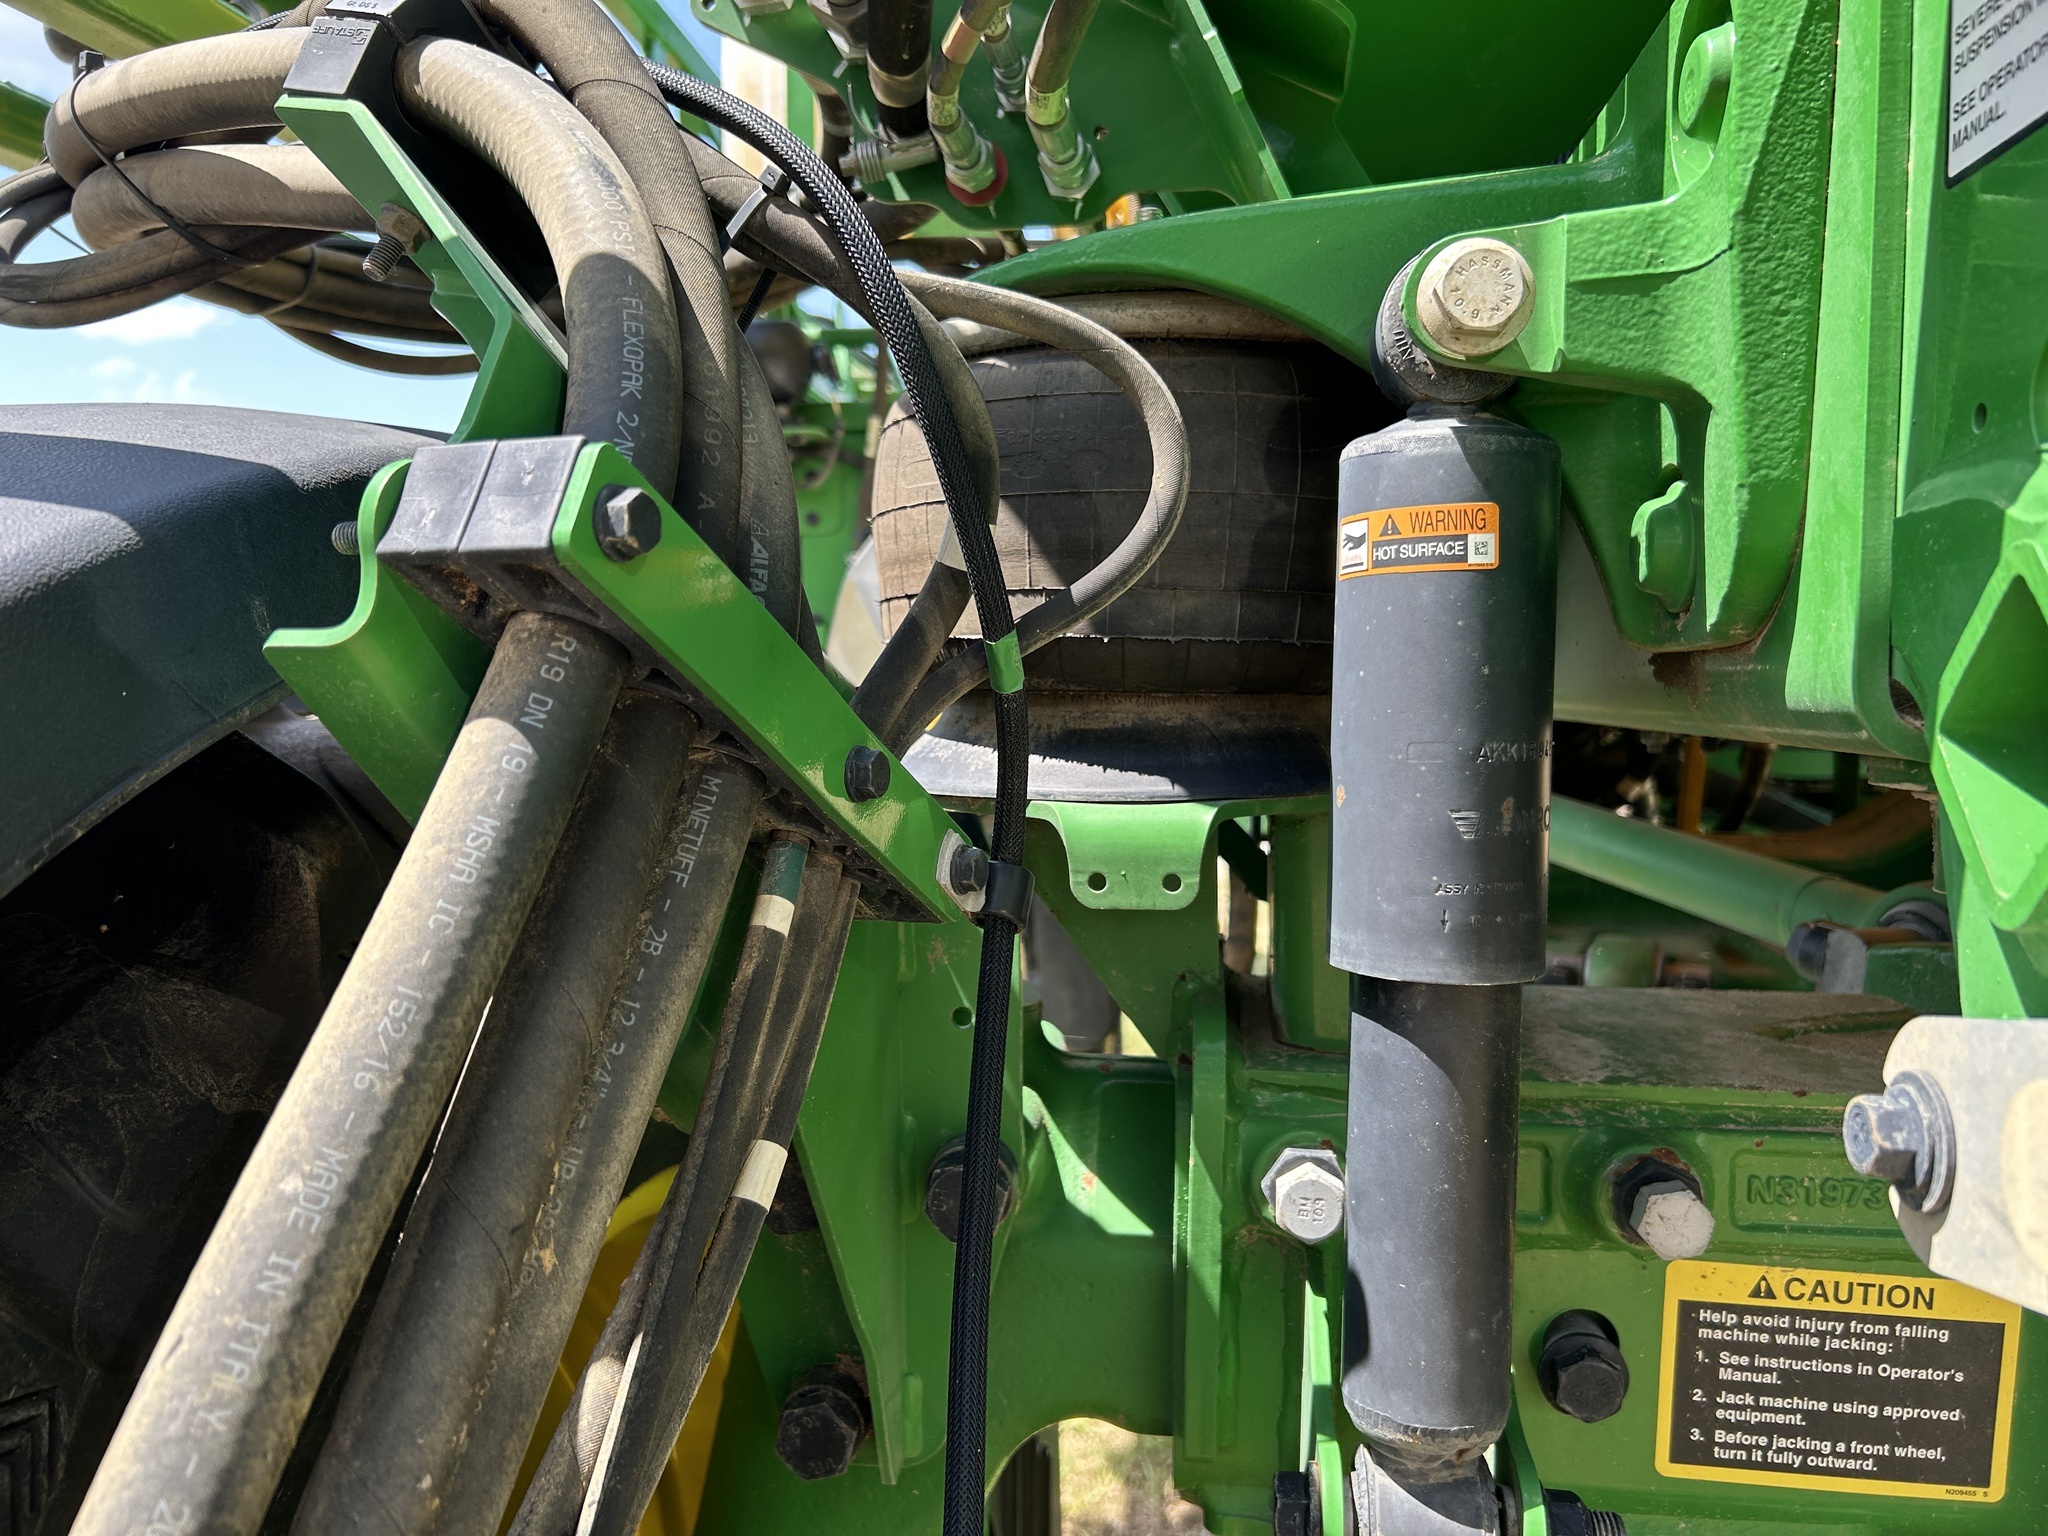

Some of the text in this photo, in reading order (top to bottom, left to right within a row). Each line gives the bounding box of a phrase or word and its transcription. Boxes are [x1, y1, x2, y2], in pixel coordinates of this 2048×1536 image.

[1954, 0, 2033, 74] SUSPENSION
[1953, 88, 1977, 122] SEE
[1952, 101, 2007, 152] MANUAL.
[619, 296, 645, 400] FLEXOPAK
[1409, 507, 1487, 533] WARNING
[1373, 541, 1465, 561] HOT SURFACE
[539, 632, 578, 683] R19
[519, 692, 554, 729] DN
[501, 742, 534, 774] 19
[668, 774, 723, 888] MINETUFF
[449, 815, 501, 885] MSHA
[1434, 882, 1469, 896] ASSY
[428, 898, 463, 936] IC
[640, 924, 668, 956] 2B
[353, 985, 424, 1092] 152/16
[286, 1147, 350, 1234] MADE
[255, 1251, 301, 1298] IN
[1783, 1277, 1935, 1311] CAUTION
[1698, 1308, 1950, 1343] Help avoid injury from falling
[1698, 1327, 1894, 1355] machine while jacking:
[198, 1319, 272, 1432] ITALY
[1695, 1350, 1965, 1382] 1. See instructions in Operator's
[1718, 1367, 1782, 1385] Manual.
[1692, 1388, 1960, 1421] 2. Jack machine using approved
[1715, 1408, 1806, 1426] equipment.
[1689, 1428, 1946, 1462] 3. Before jacking a front wheel,
[1713, 1446, 1878, 1471] turn it fully outward.
